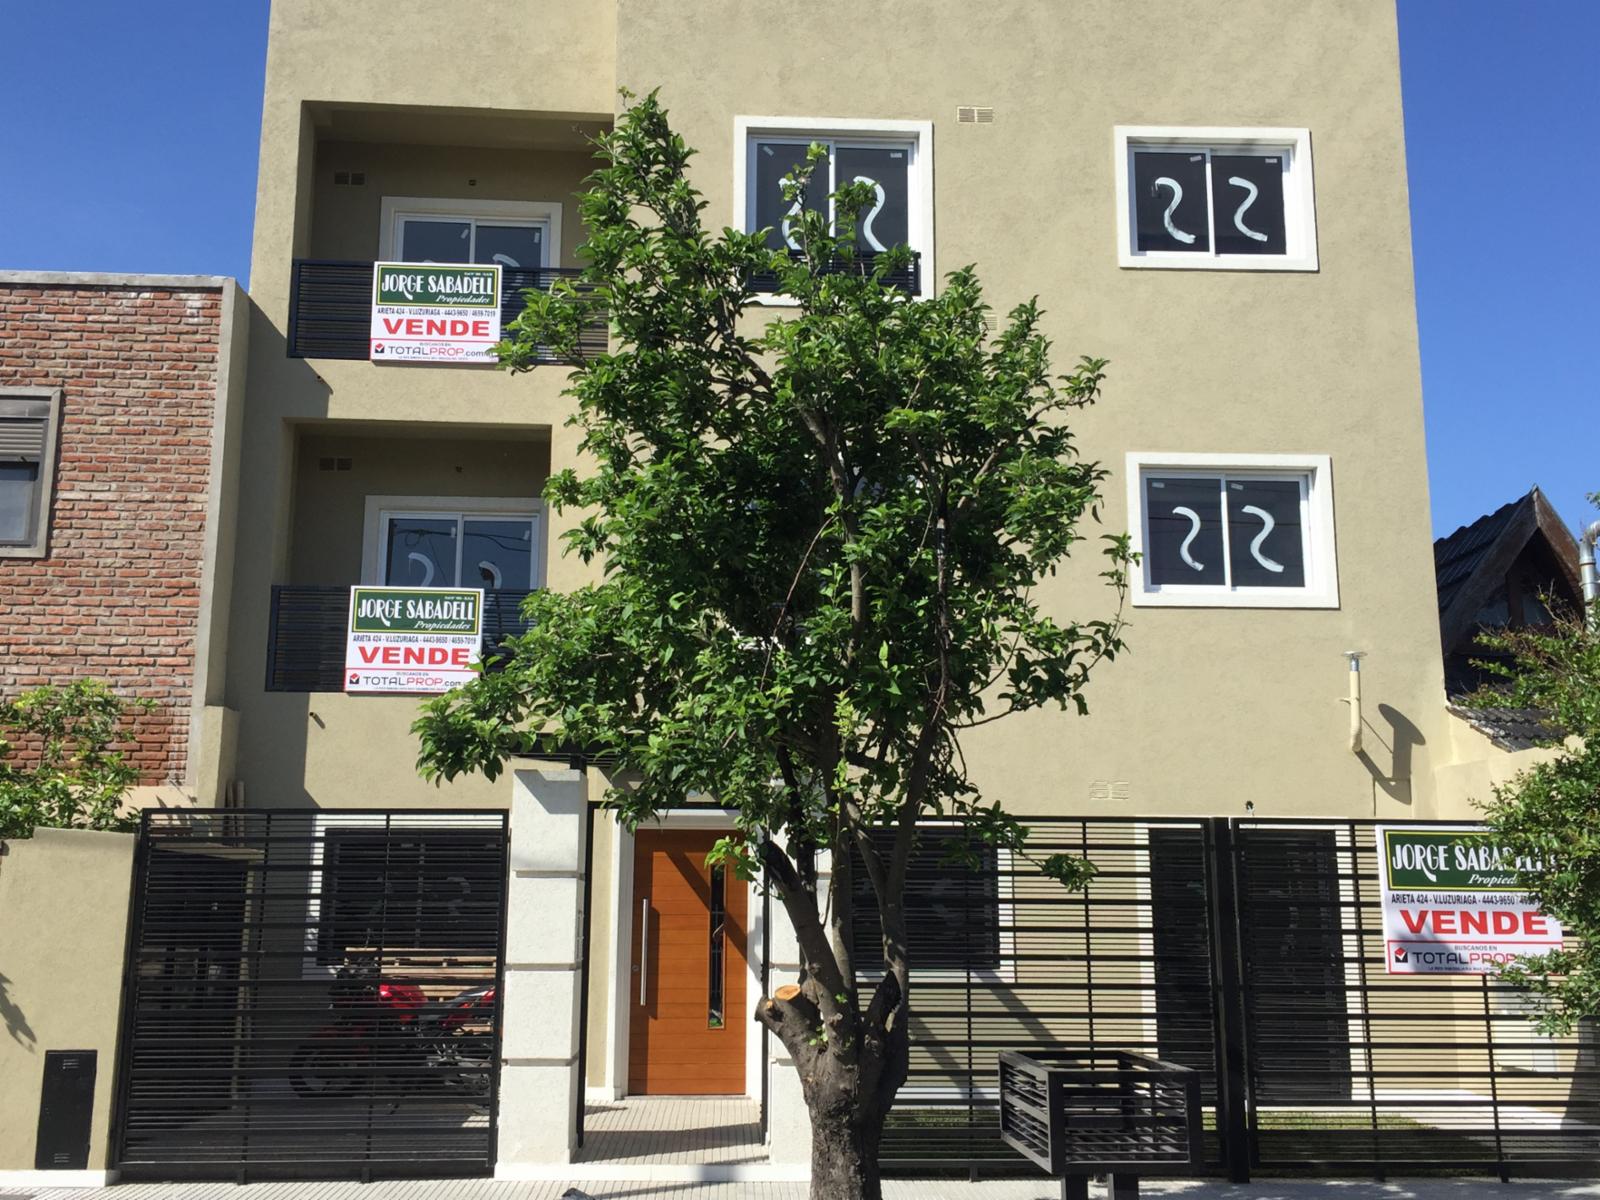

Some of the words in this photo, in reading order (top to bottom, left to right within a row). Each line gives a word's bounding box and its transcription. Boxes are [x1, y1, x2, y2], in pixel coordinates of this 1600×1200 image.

[382, 274, 424, 301] JORGE
[428, 274, 494, 295] SABADELL
[435, 294, 490, 305] Propiedades
[383, 318, 490, 337] VENDE
[358, 598, 403, 627] JORGE
[406, 598, 475, 620] SABADELL
[413, 620, 472, 631] Propiedades
[353, 634, 372, 642] ARIETA
[358, 646, 470, 665] VENDE
[1392, 843, 1450, 882] JORGE
[1467, 873, 1519, 887] Propied
[1391, 894, 1416, 904] ARIETA
[1416, 895, 1429, 904] 424
[1433, 895, 1477, 905] V.LUZURIAGA
[1482, 895, 1515, 905] 4443-9650
[1399, 910, 1548, 935] VENDE
